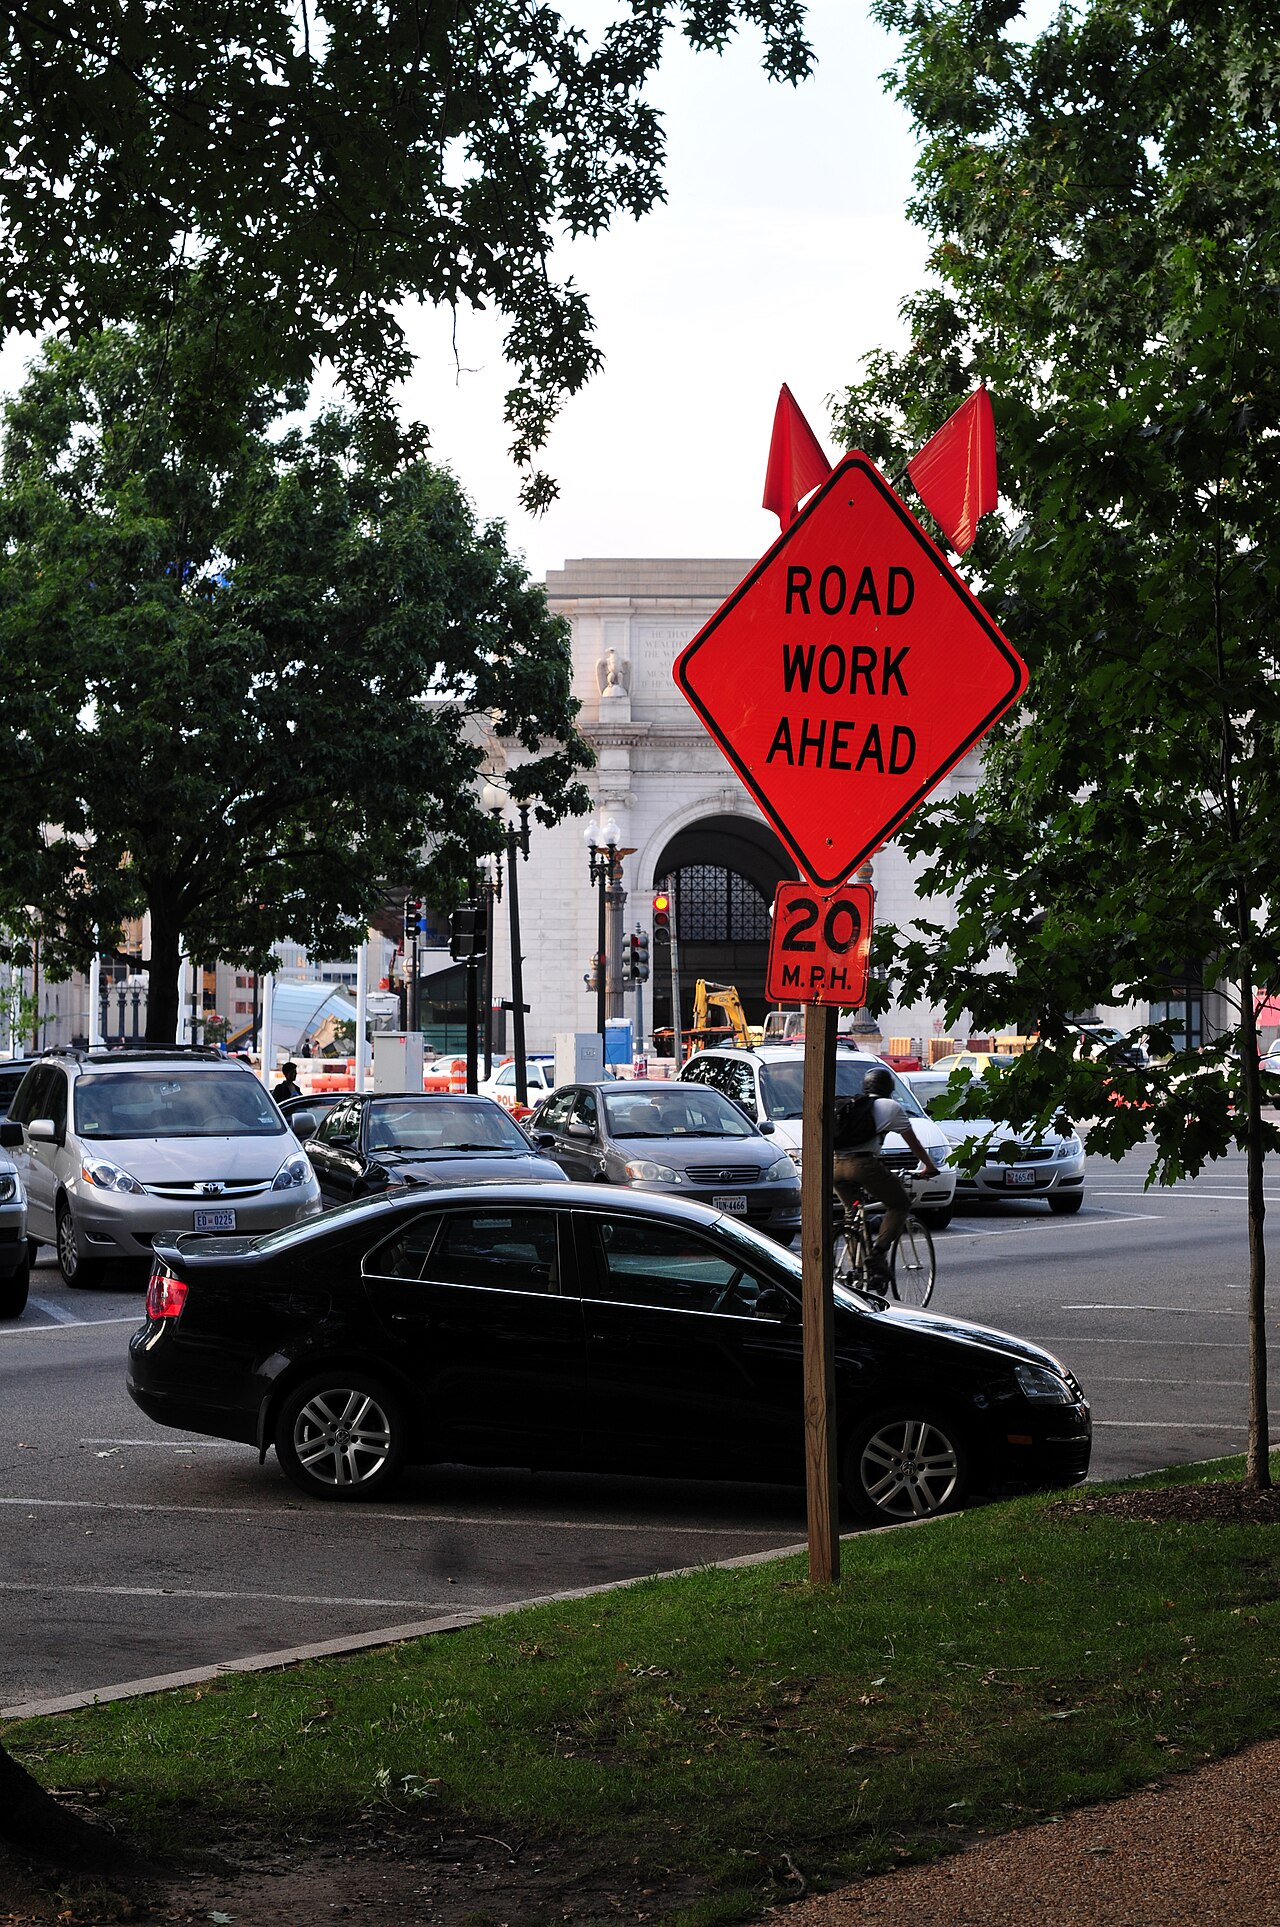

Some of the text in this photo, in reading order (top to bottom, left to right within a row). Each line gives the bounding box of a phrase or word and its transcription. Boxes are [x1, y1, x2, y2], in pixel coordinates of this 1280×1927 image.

[785, 565, 915, 616] ROAD
[783, 644, 911, 696] WORK
[765, 716, 916, 775] AHEAD
[781, 898, 861, 954] 20
[781, 964, 852, 990] M.P.H.
[497, 1094, 517, 1106] POLI
[197, 1215, 233, 1226] ED 0225
